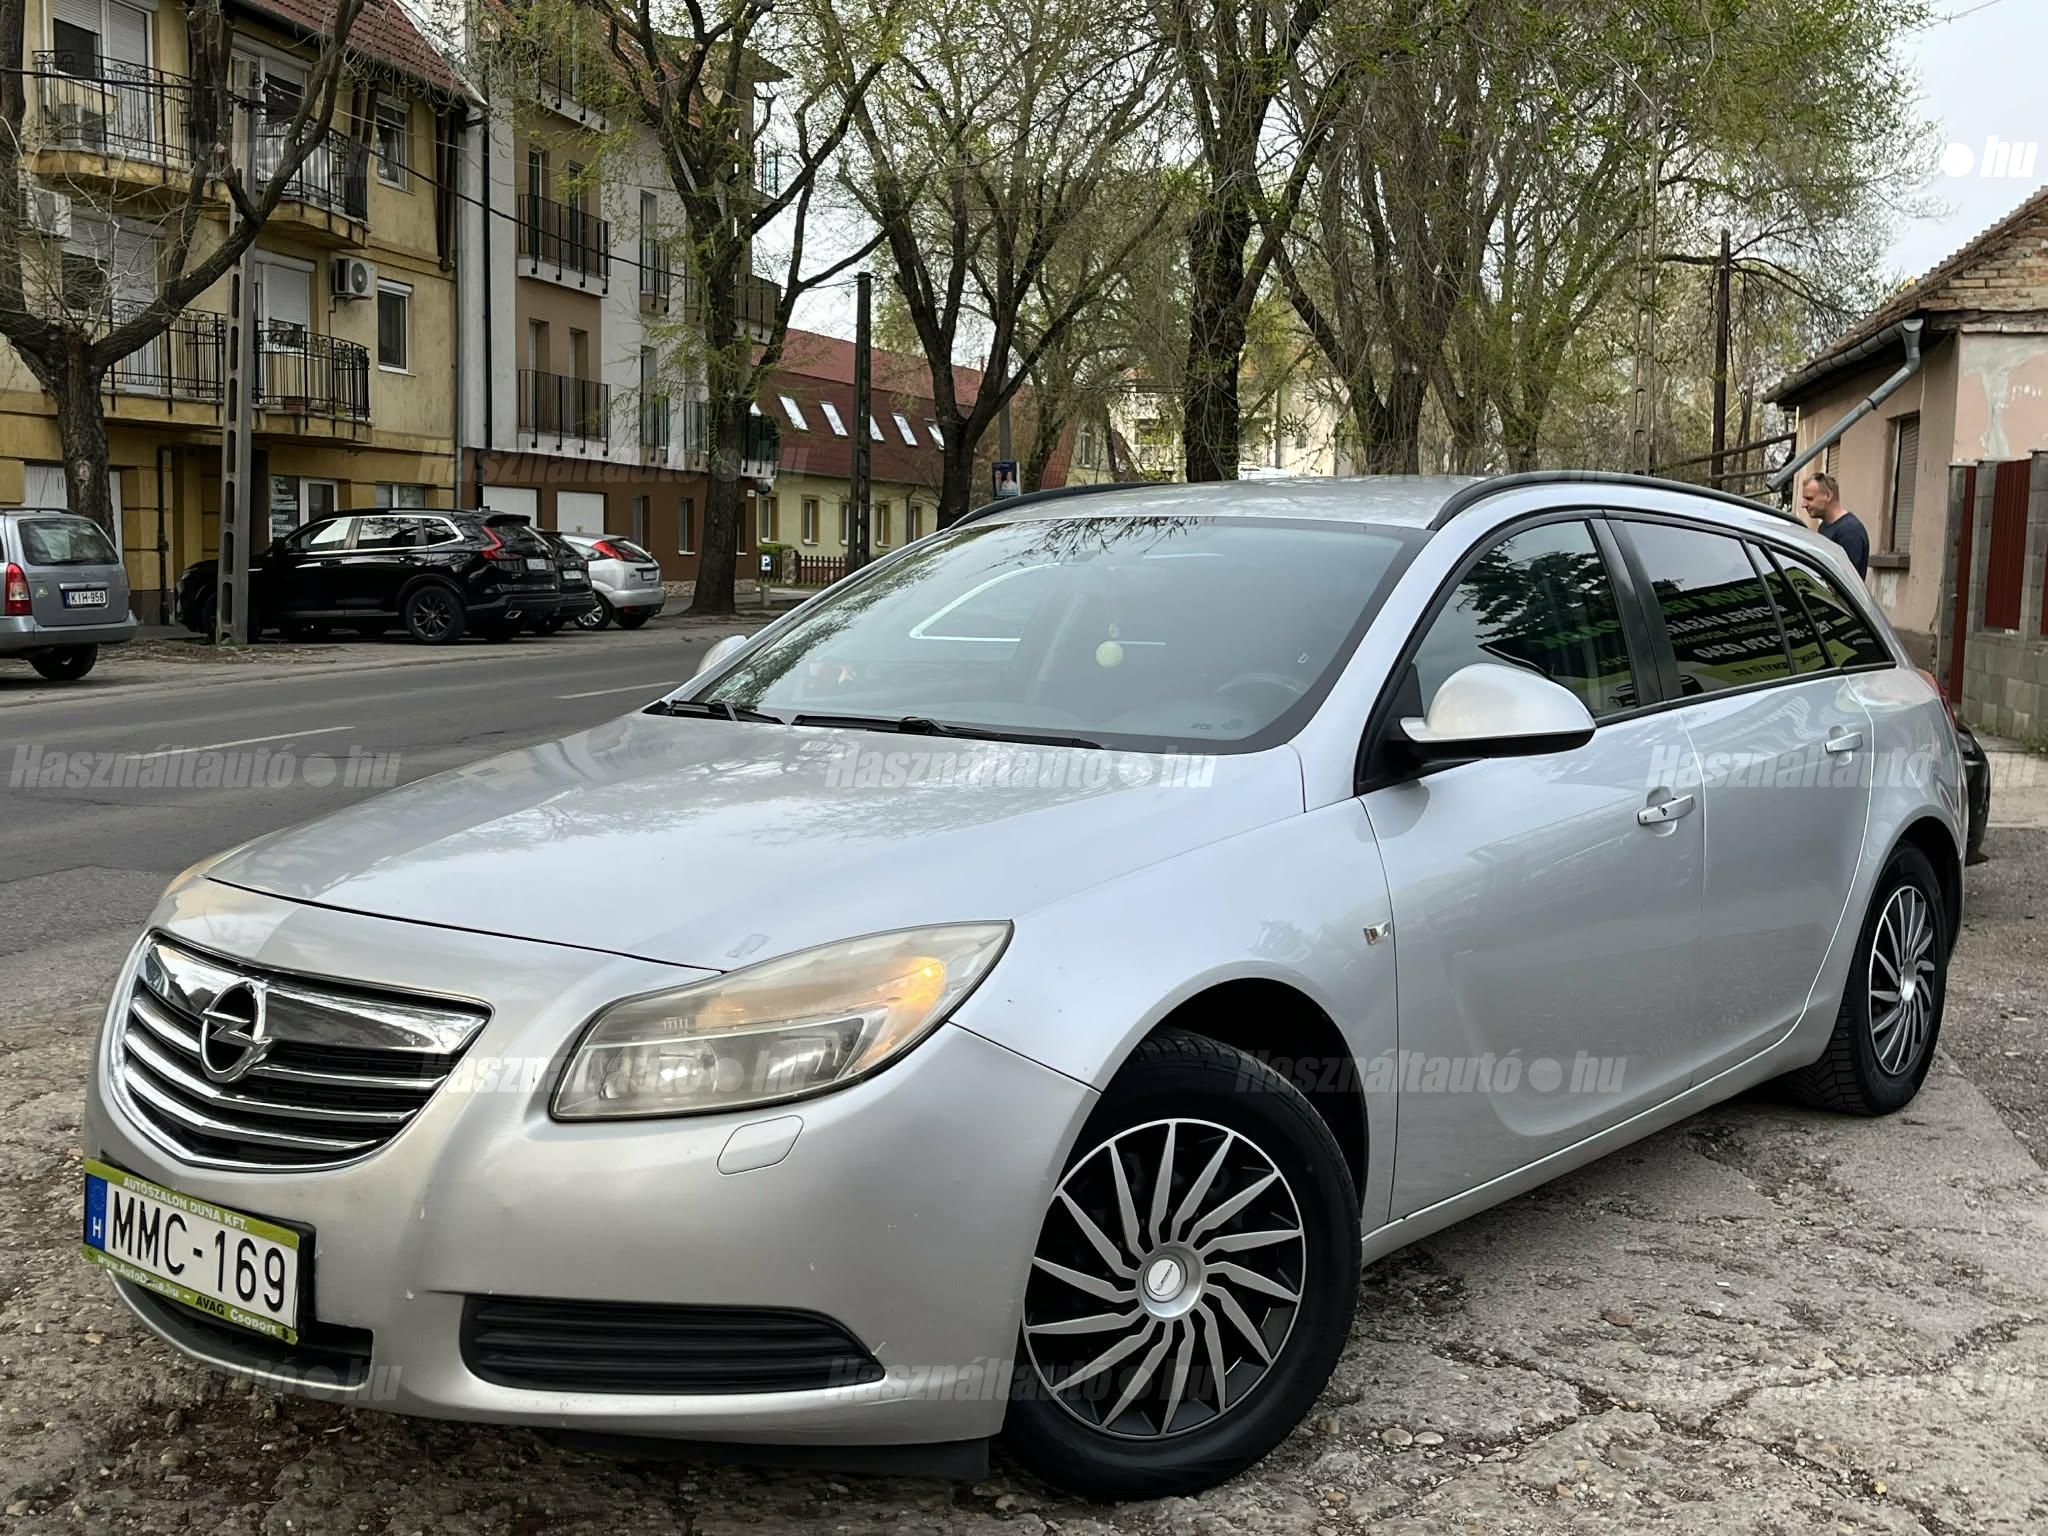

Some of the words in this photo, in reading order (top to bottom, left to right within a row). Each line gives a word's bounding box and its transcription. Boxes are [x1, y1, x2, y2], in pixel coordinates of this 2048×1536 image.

[71, 591, 104, 604] KIH-958
[123, 1176, 187, 1209] AUTÓSZALON
[190, 1201, 221, 1223] DUNA
[224, 1213, 248, 1231] KFT.
[92, 1216, 102, 1239] H
[112, 1191, 286, 1313] MMC-169
[195, 1295, 225, 1316] AVAG
[229, 1306, 277, 1336] Csoport
